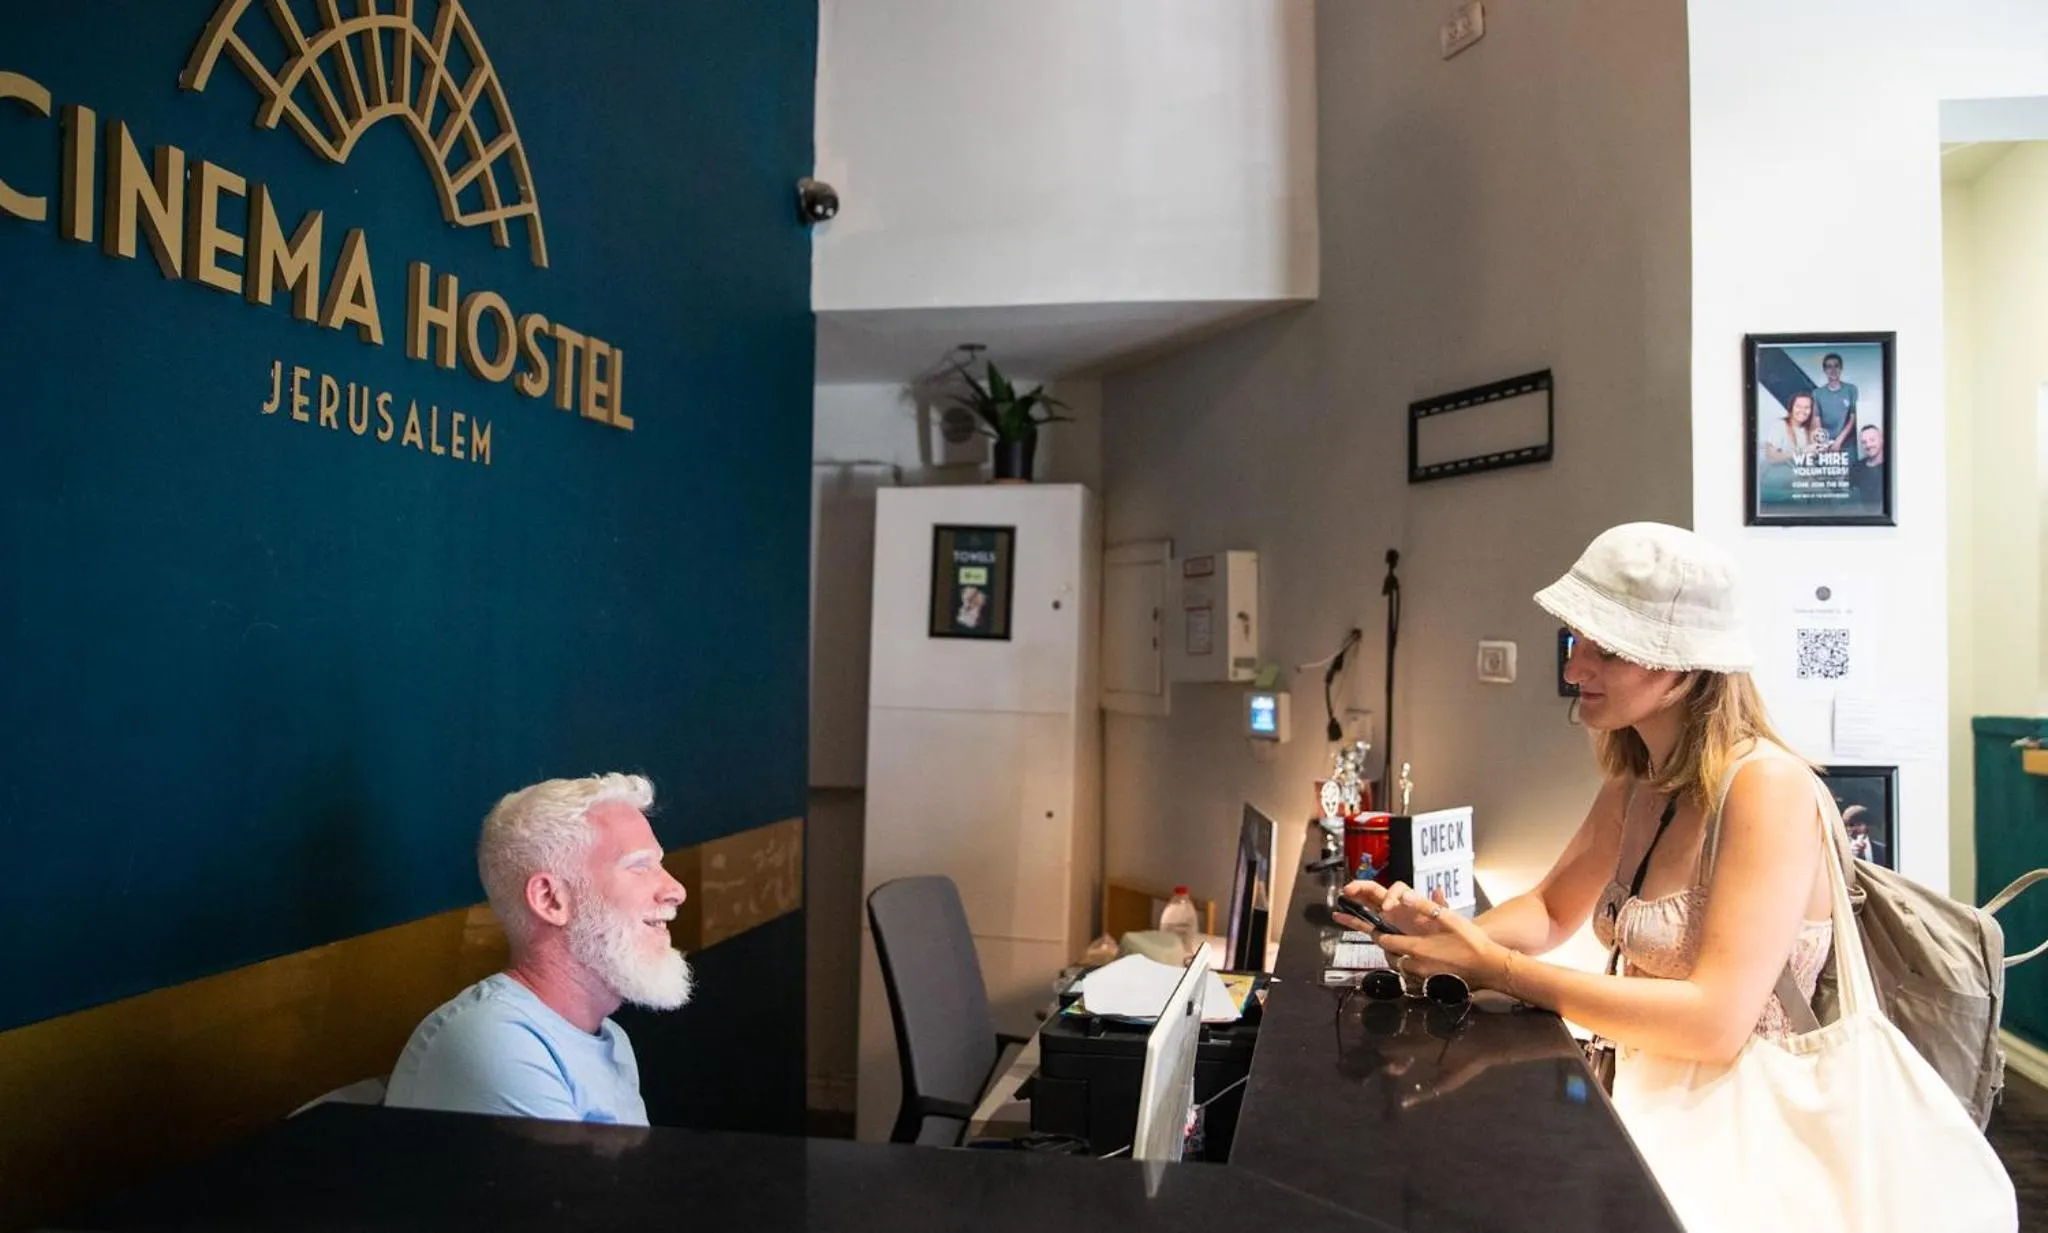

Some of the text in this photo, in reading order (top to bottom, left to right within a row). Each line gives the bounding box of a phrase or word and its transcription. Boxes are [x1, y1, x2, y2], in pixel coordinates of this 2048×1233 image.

[406, 261, 634, 430] HOSTEL
[262, 360, 492, 465] JERUSALEM
[1792, 452, 1849, 466] WE HIRE
[953, 550, 997, 564] TOWELS
[1421, 820, 1465, 856] CHECK
